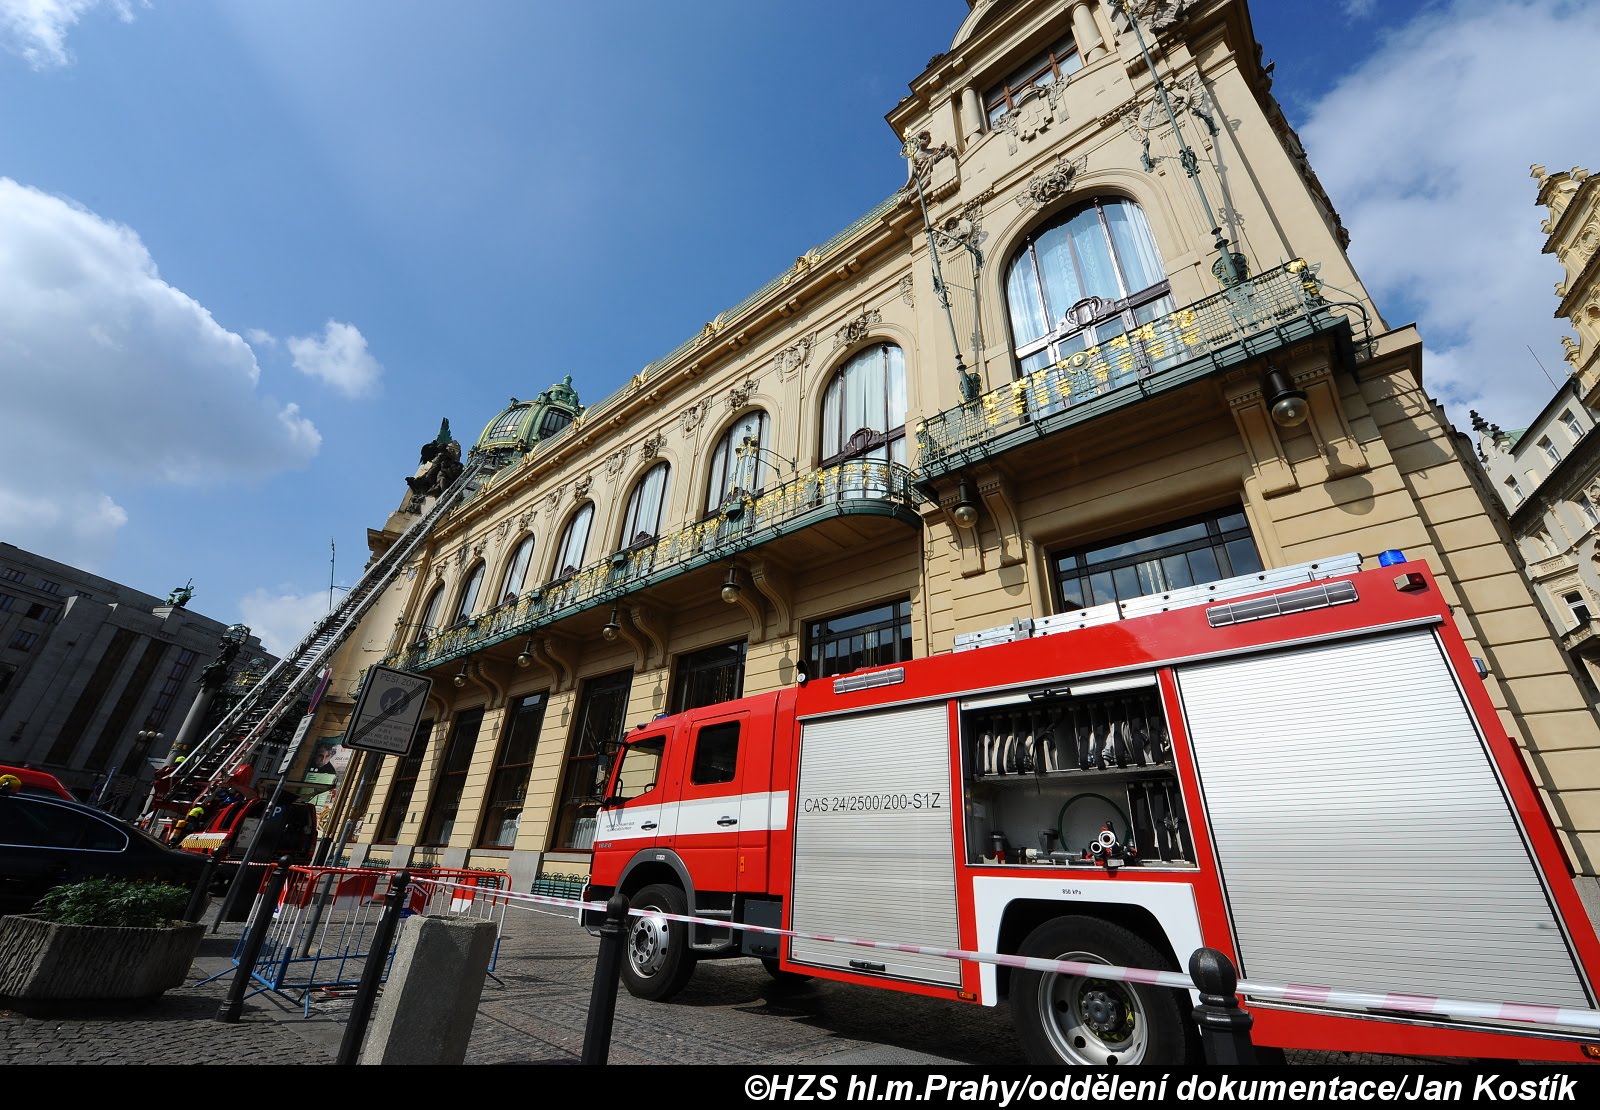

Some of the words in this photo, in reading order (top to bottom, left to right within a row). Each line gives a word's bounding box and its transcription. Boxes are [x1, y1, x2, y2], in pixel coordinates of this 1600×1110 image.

[804, 797, 829, 813] CAS
[832, 792, 941, 812] 24/2500/200-S1Z
[272, 806, 282, 817] P
